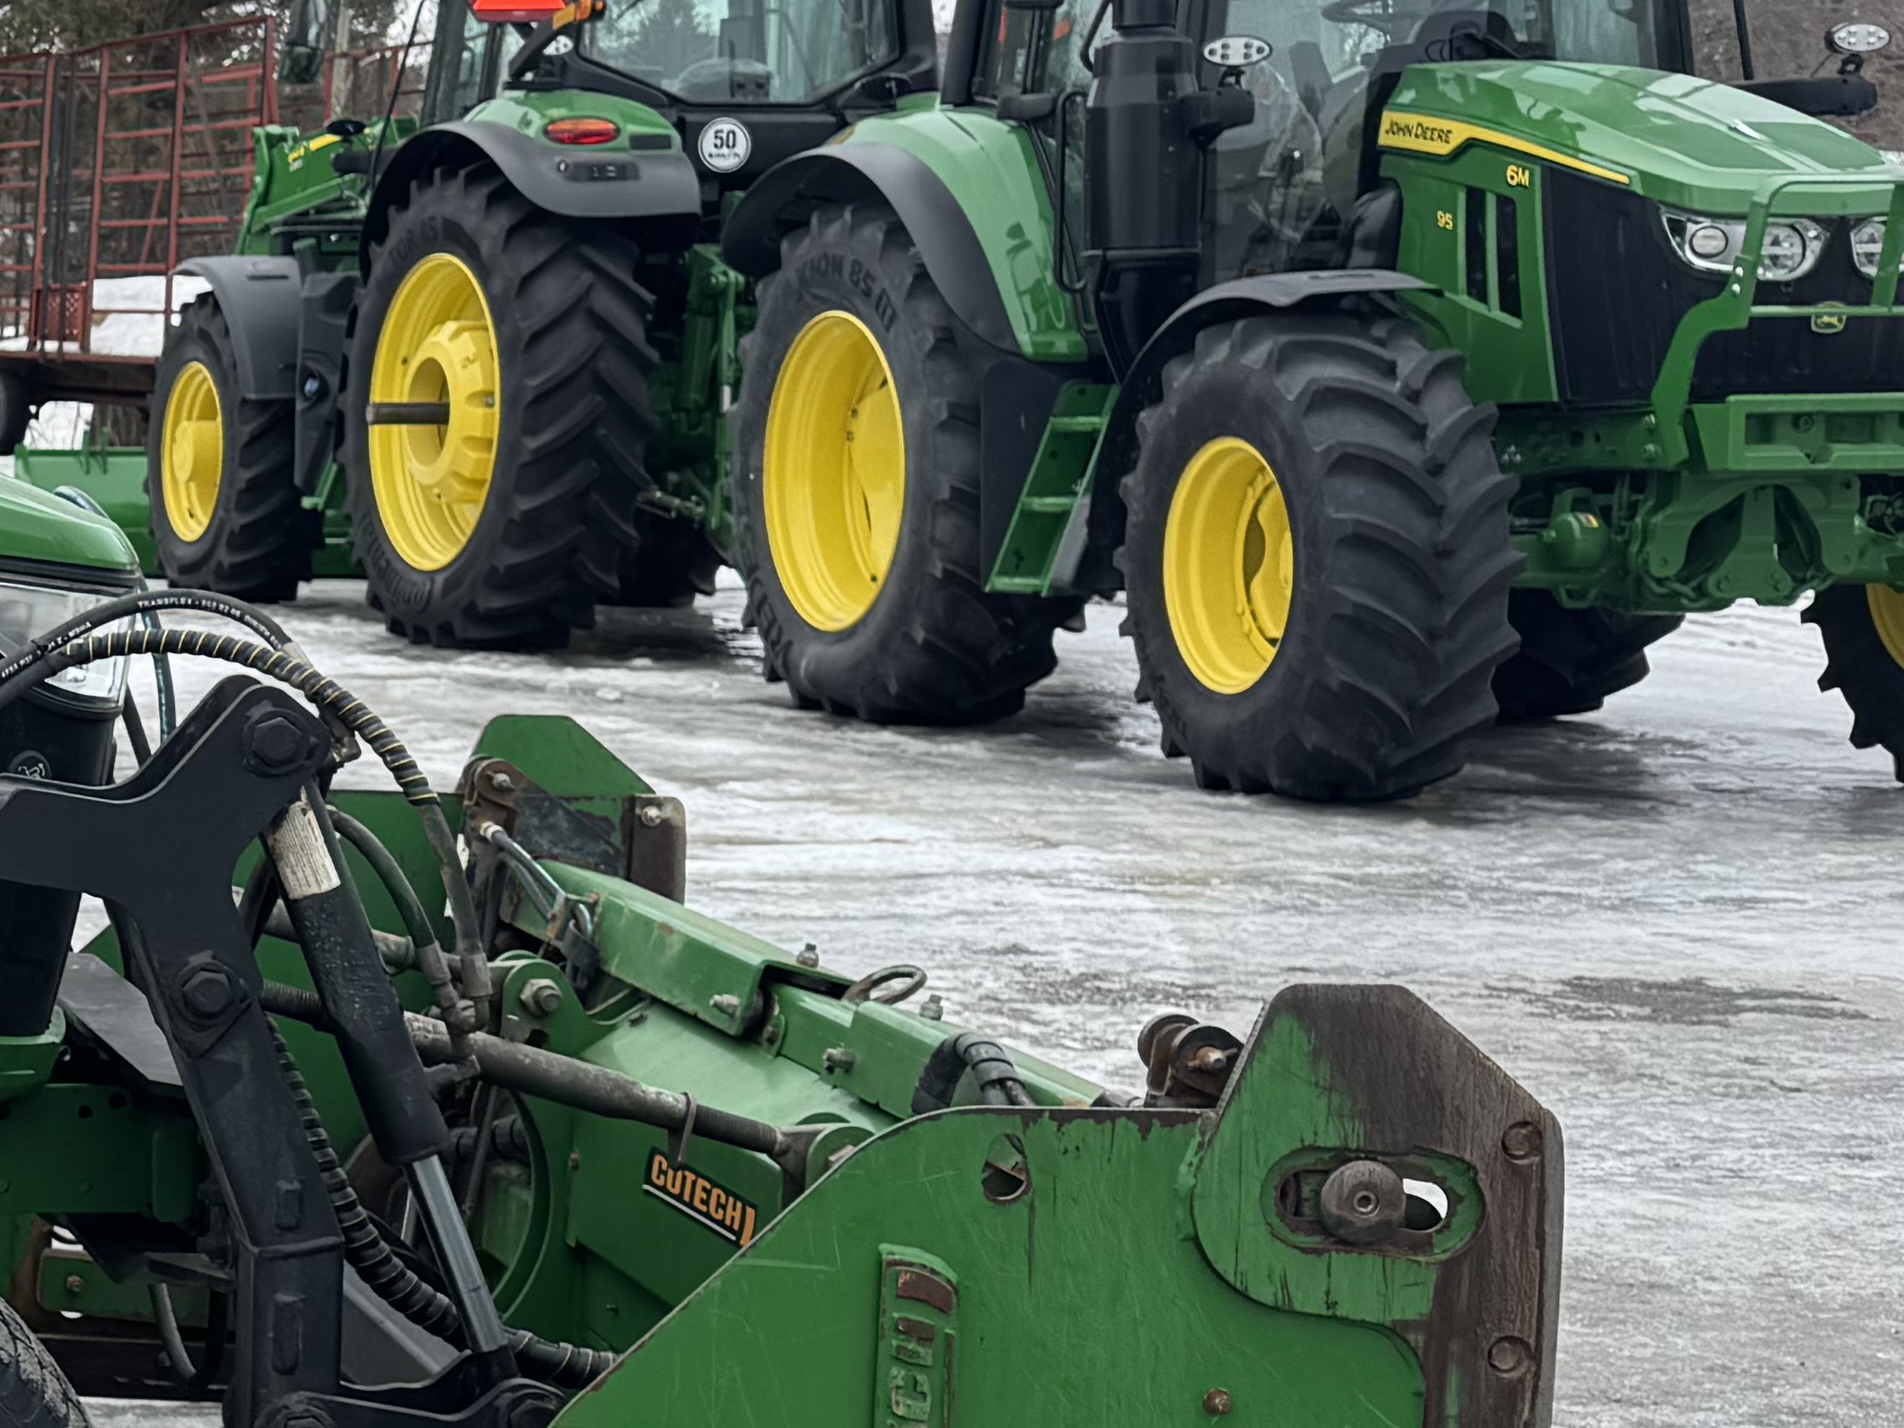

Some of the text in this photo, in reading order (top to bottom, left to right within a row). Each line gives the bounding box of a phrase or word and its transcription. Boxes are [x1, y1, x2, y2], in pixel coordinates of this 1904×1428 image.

[712, 128, 737, 150] 50
[1384, 119, 1453, 145] JOHN DEERE
[1506, 164, 1530, 188] 6M
[1437, 210, 1454, 230] 95
